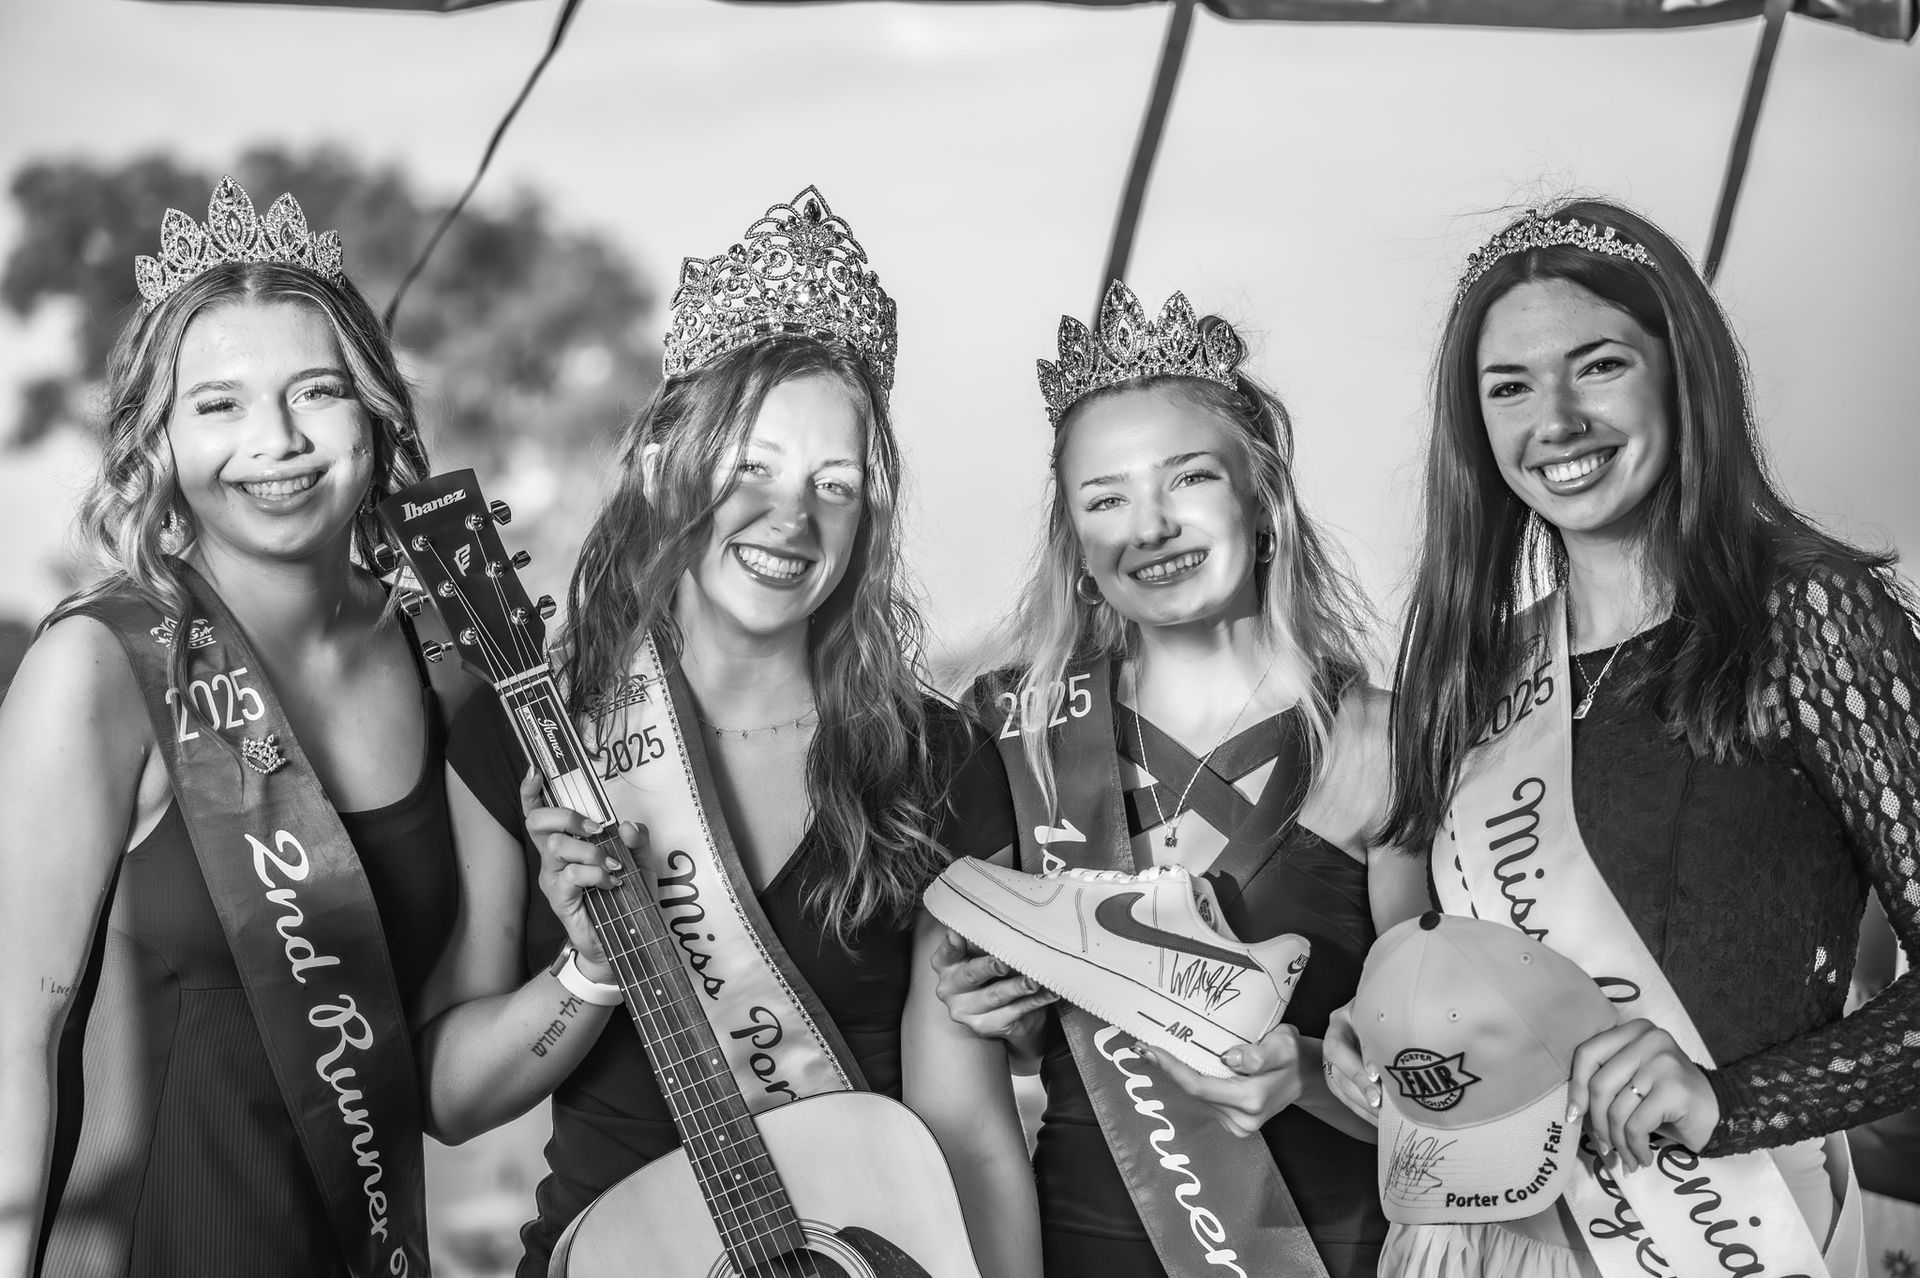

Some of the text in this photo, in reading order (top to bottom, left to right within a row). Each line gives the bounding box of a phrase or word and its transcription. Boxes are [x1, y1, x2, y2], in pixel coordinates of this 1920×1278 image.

[401, 489, 467, 522] Ibanez
[165, 667, 265, 742] 2025
[995, 673, 1092, 740] 2025
[1475, 660, 1555, 747] 025
[537, 717, 565, 759] Ibanez
[603, 725, 666, 781] 2025
[658, 850, 799, 1101] Miss Por
[559, 995, 585, 1018] ולד
[244, 829, 389, 1244] 2nd Runner
[1165, 1021, 1194, 1043] AIR
[1400, 1053, 1433, 1066] PORTER
[1401, 1065, 1460, 1096] FAIR
[1420, 1092, 1458, 1108] COUNTY
[1445, 1120, 1563, 1208] Porter County Fair
